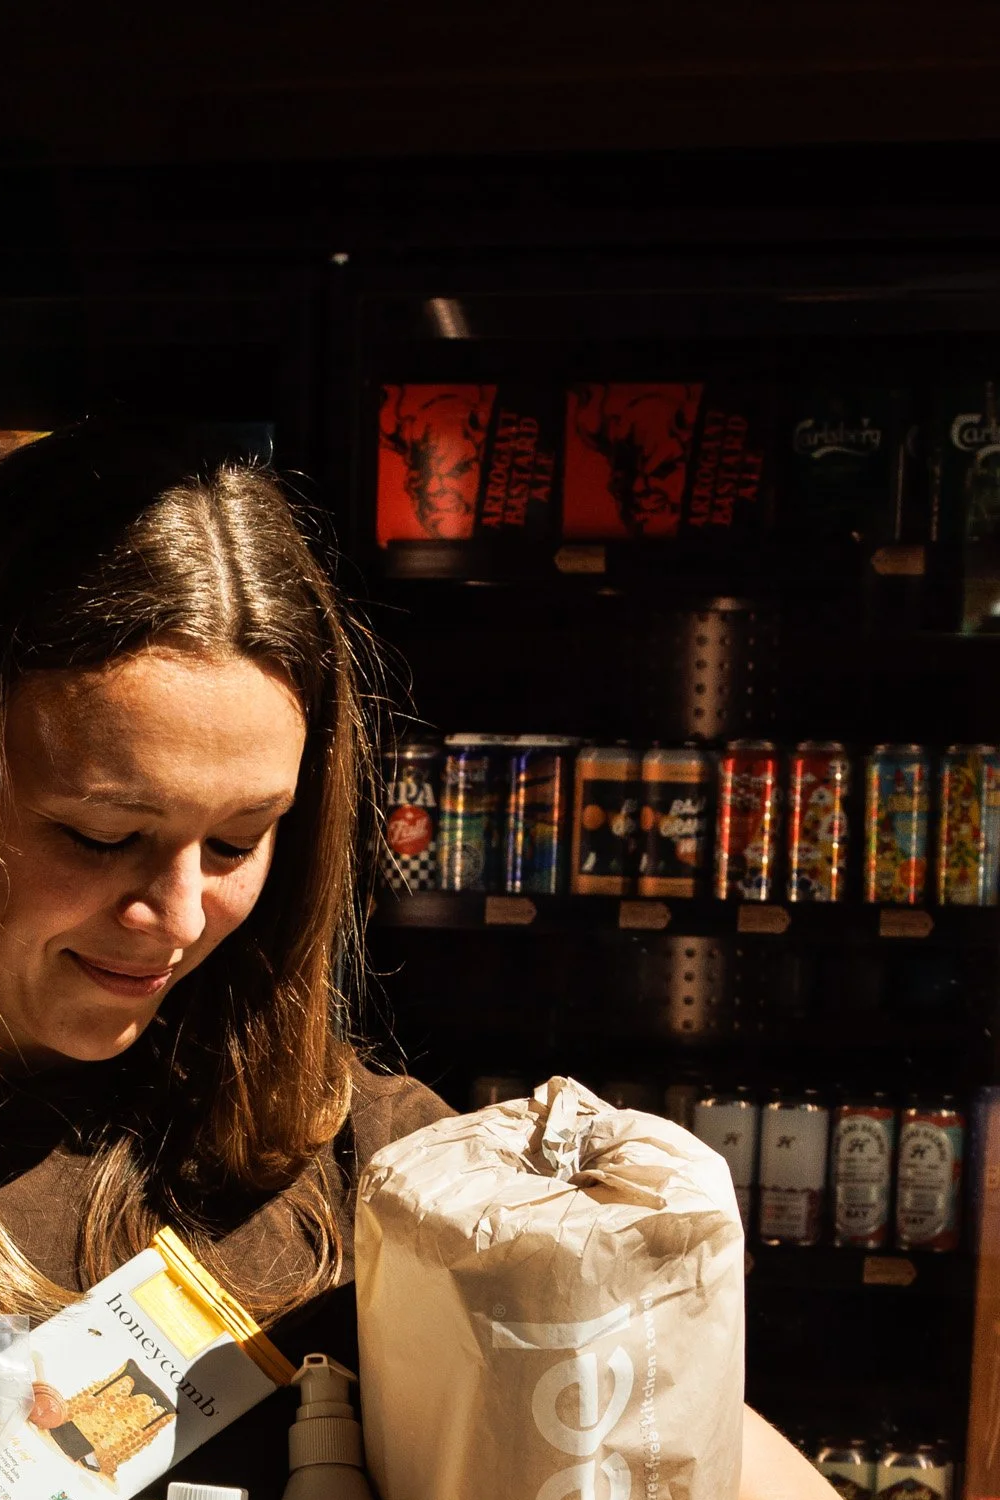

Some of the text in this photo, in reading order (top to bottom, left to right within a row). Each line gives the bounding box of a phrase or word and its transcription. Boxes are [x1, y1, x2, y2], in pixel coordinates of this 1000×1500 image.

[386, 781, 438, 808] IPA
[640, 1291, 656, 1350] towel
[105, 1292, 217, 1419] honeycomb
[640, 1354, 657, 1425] kitchen
[646, 1430, 661, 1469] free
